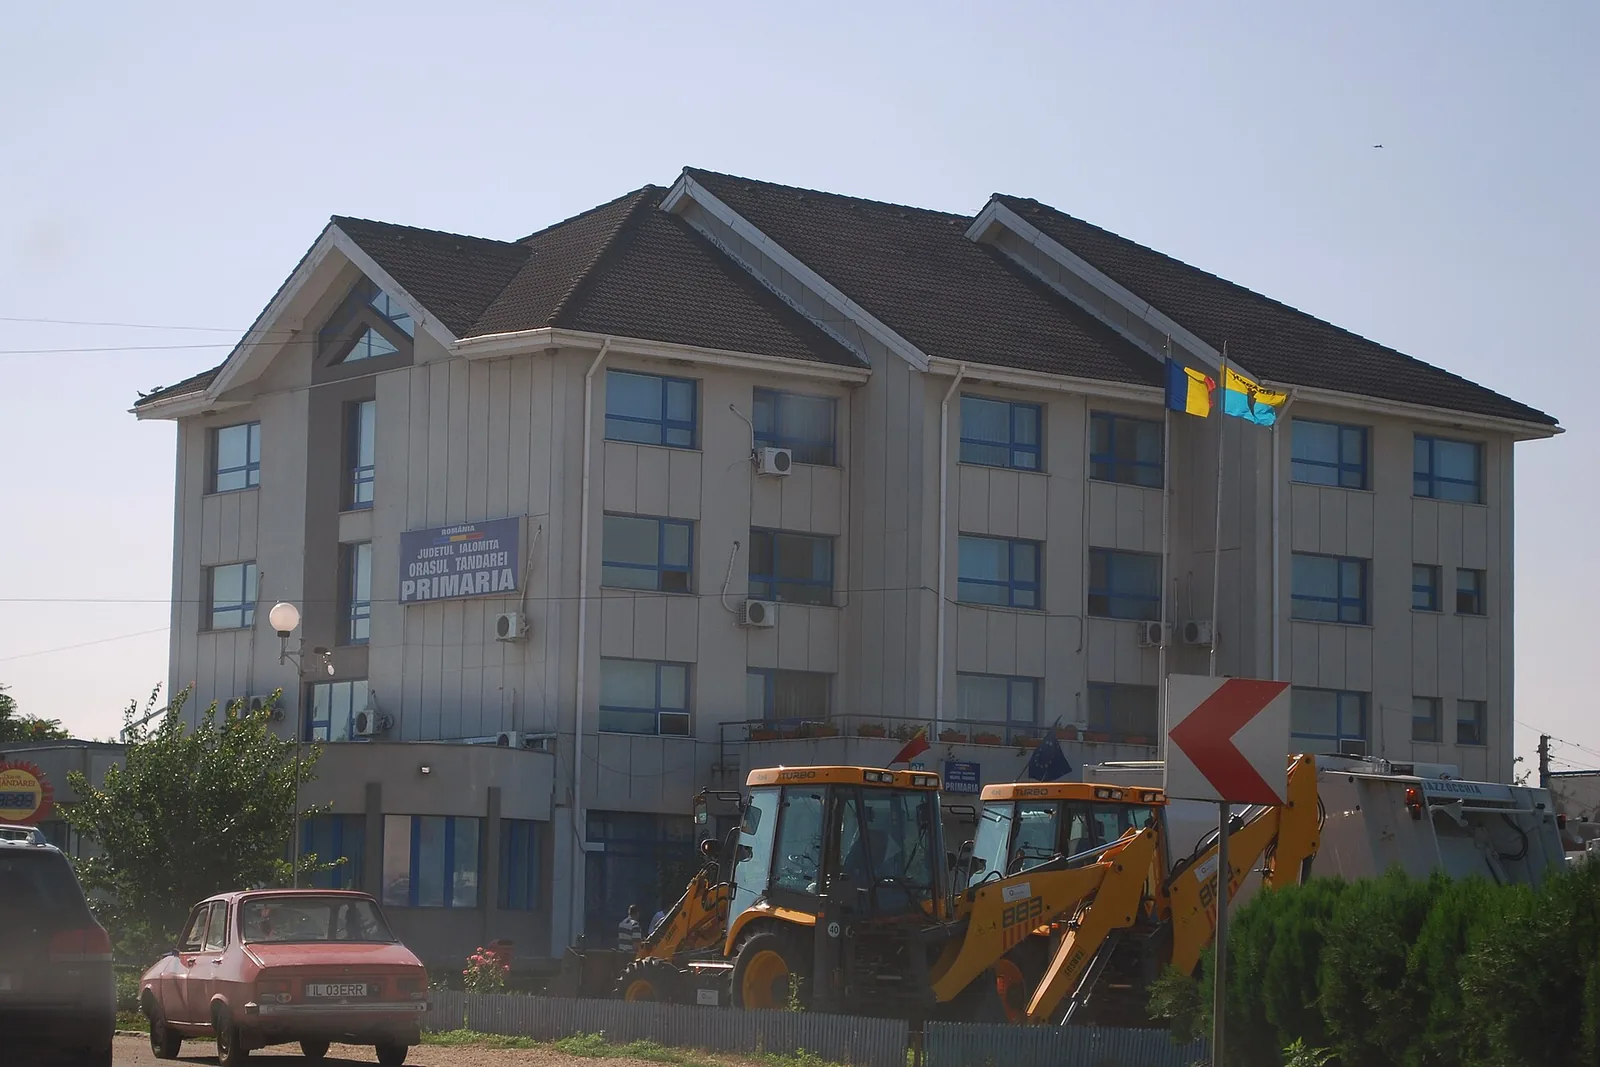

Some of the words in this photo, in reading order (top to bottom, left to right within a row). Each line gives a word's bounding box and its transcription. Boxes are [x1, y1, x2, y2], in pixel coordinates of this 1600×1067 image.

[417, 544, 454, 559] JUDETUL
[459, 539, 500, 553] IALOMITA
[409, 558, 449, 577] ORASUL
[455, 551, 508, 571] TANDAREI
[401, 568, 515, 601] PRIMARIA
[781, 771, 816, 779] TURBO
[945, 782, 979, 792] PRIMARIA
[1016, 788, 1048, 796] TURBO
[313, 985, 322, 995] IL
